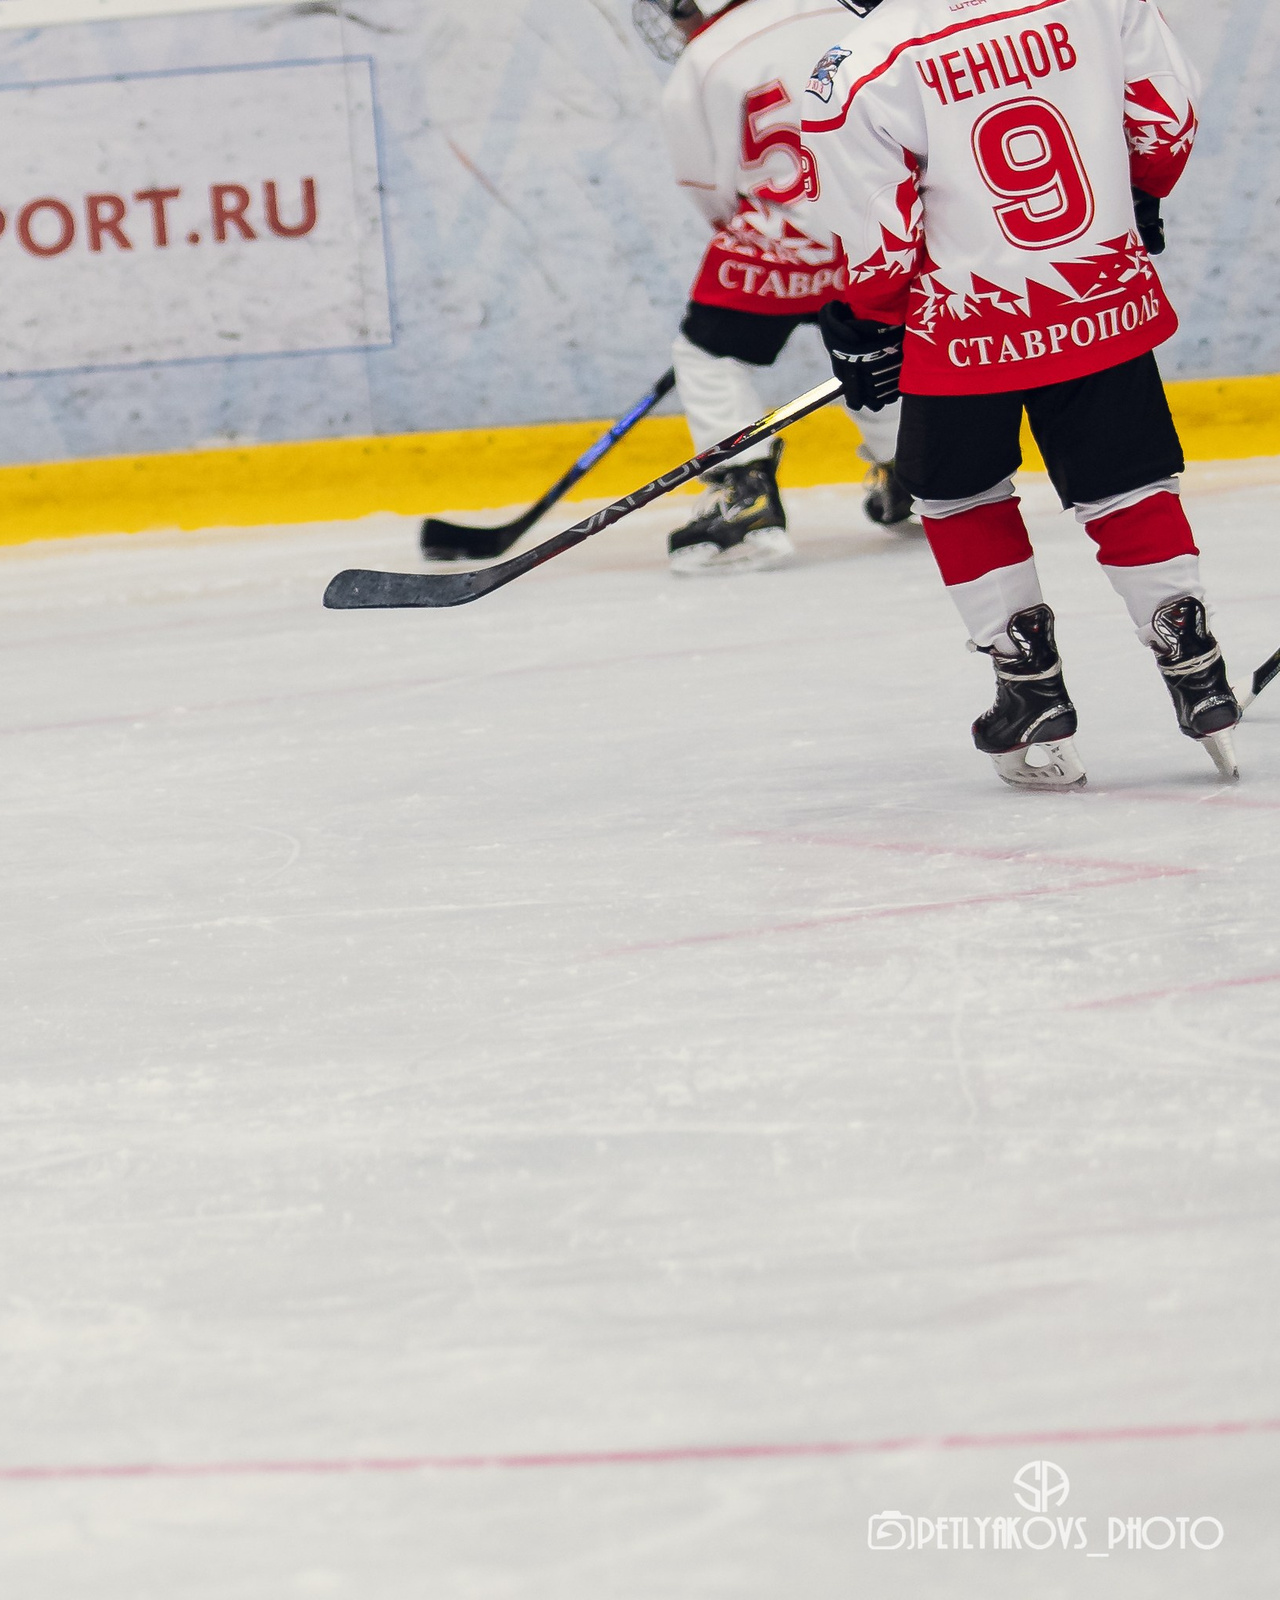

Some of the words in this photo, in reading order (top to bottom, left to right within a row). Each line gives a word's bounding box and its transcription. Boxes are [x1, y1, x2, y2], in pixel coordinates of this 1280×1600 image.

[916, 22, 1077, 106] ЧЕНЦОВ
[970, 96, 1095, 251] 9
[947, 288, 1159, 368] СТАВРОПОЛЬ
